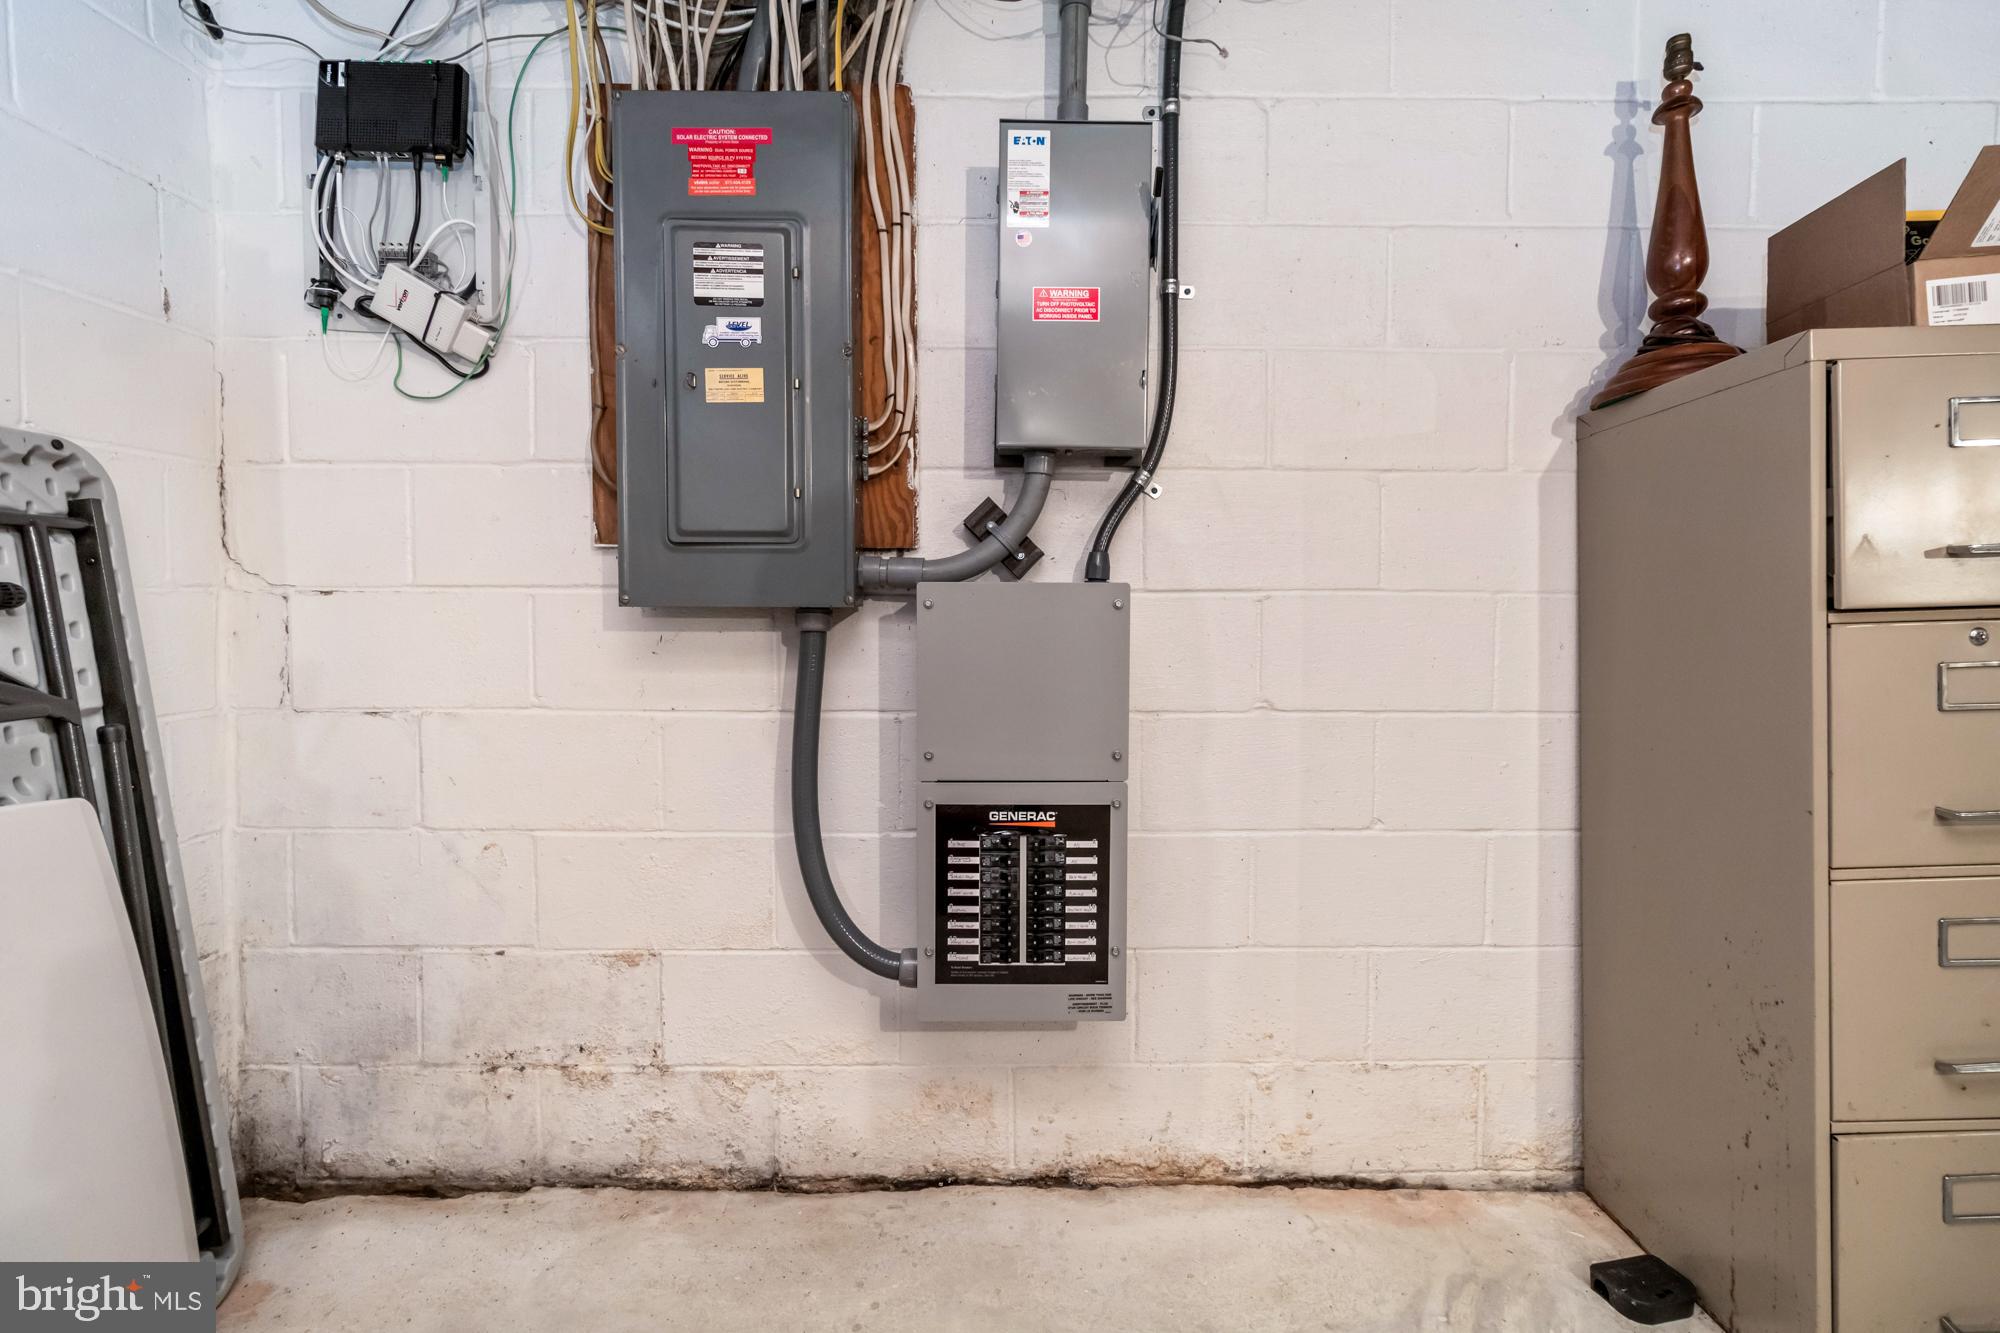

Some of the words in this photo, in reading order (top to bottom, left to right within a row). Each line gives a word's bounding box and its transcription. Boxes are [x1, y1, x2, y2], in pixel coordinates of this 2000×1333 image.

[1049, 289, 1089, 297] WARNING
[396, 289, 409, 311] verizon
[989, 811, 1056, 821] GENERAC
